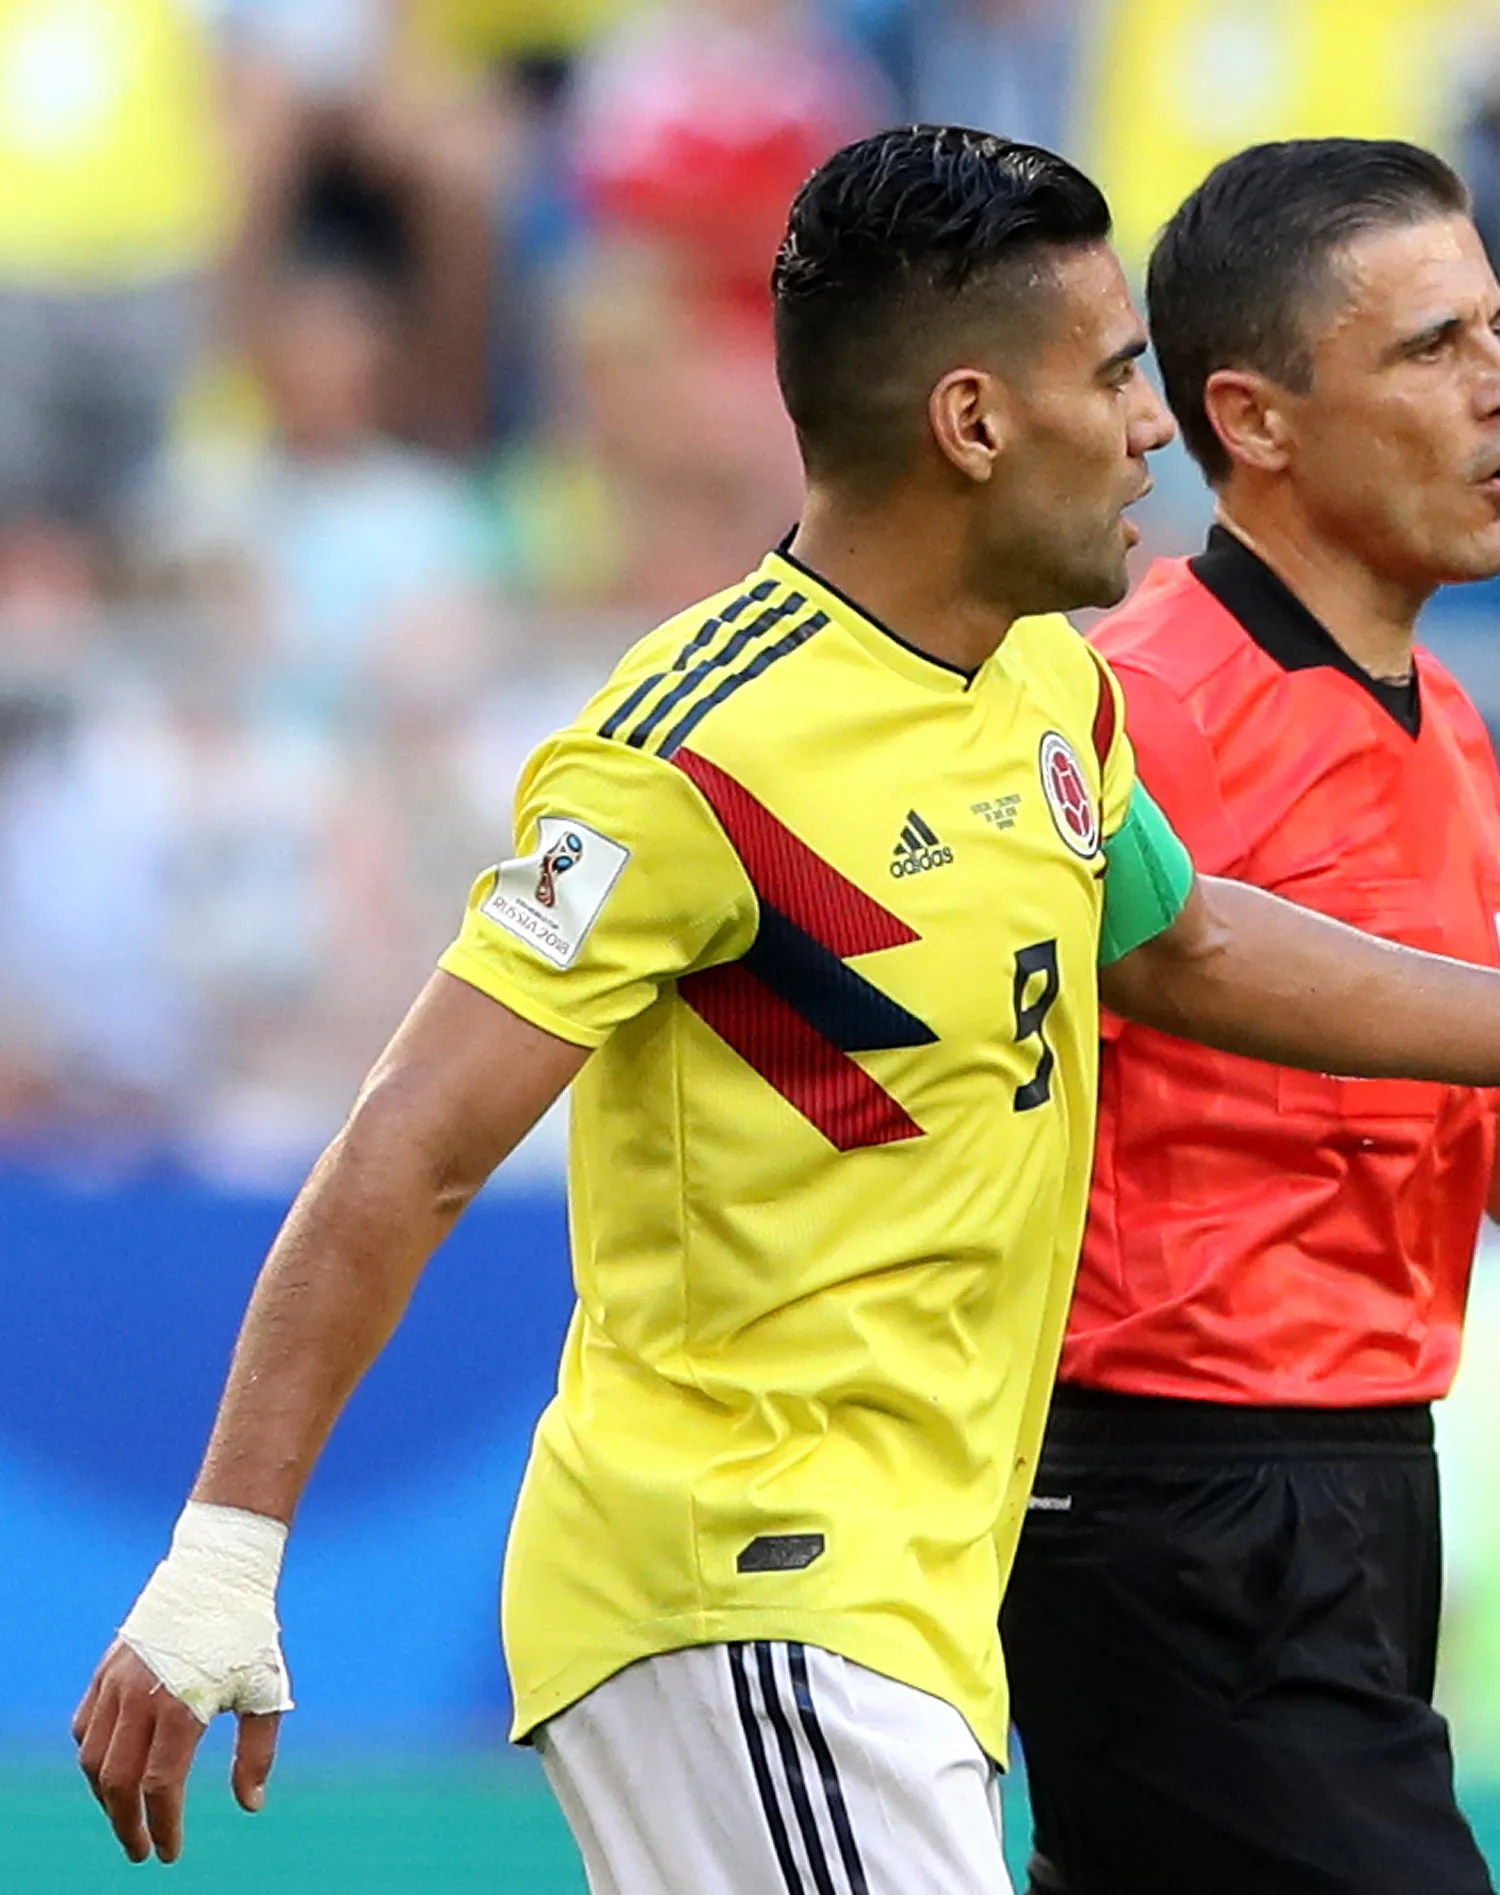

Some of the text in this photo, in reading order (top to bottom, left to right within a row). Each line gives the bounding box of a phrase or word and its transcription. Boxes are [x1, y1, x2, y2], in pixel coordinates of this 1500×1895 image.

[889, 846, 954, 879] adidas
[492, 896, 538, 934] RUSSIA
[536, 926, 571, 956] 2018
[1013, 938, 1060, 1113] 9
